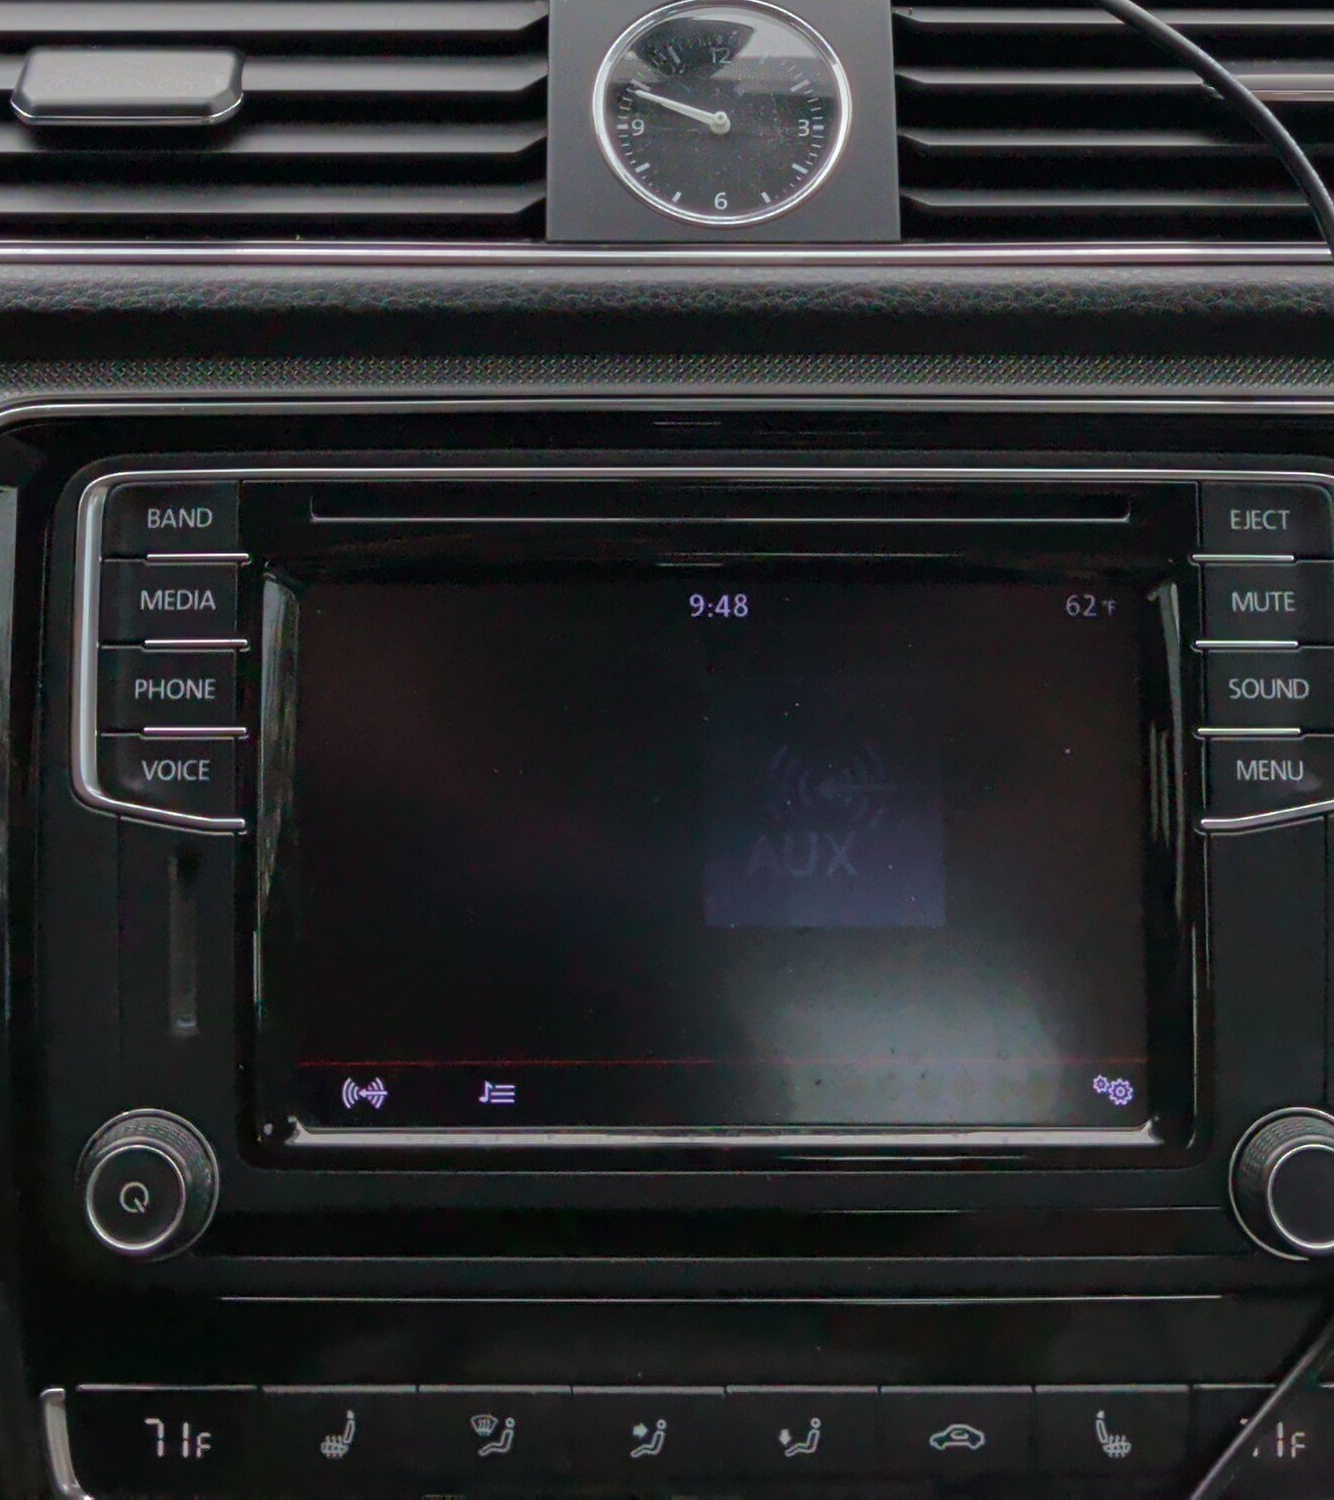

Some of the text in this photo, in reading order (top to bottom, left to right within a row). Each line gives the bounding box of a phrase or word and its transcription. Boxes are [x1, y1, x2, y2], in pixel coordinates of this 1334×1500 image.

[710, 48, 731, 65] 12
[631, 118, 646, 136] 9
[797, 118, 810, 136] 3
[713, 191, 728, 210] 6
[147, 507, 213, 529] BAND
[1230, 509, 1291, 530] EJECT
[140, 589, 216, 611] MEDIA
[689, 593, 749, 618] 9:48
[1231, 591, 1296, 612] MUTE
[134, 678, 216, 700] PHONE
[1228, 678, 1310, 700] SOUND
[142, 759, 210, 781] VOICE
[1236, 760, 1304, 781] MENU
[747, 831, 857, 876] AUX
